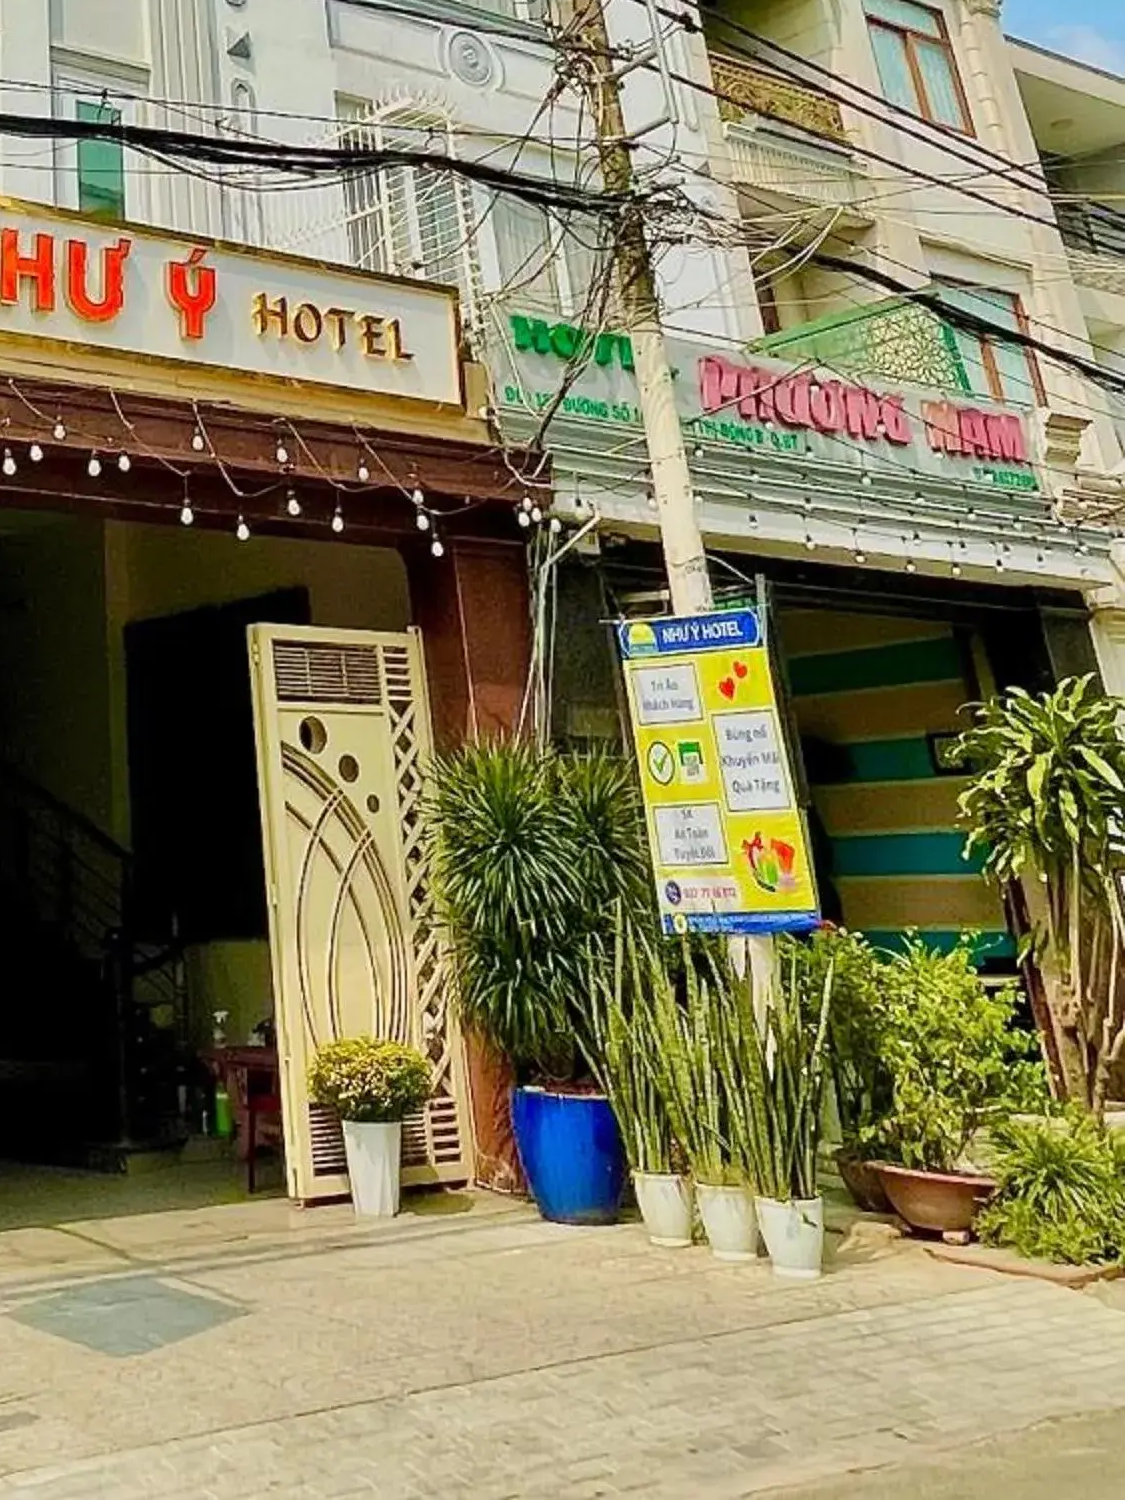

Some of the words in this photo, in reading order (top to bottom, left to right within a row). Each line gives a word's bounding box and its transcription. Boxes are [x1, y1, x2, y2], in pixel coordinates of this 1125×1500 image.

[168, 247, 217, 339] Ý
[252, 291, 413, 361] HOTEL
[920, 400, 1030, 465] NAM
[690, 620, 700, 641] Ý
[701, 620, 744, 639] HOTEL
